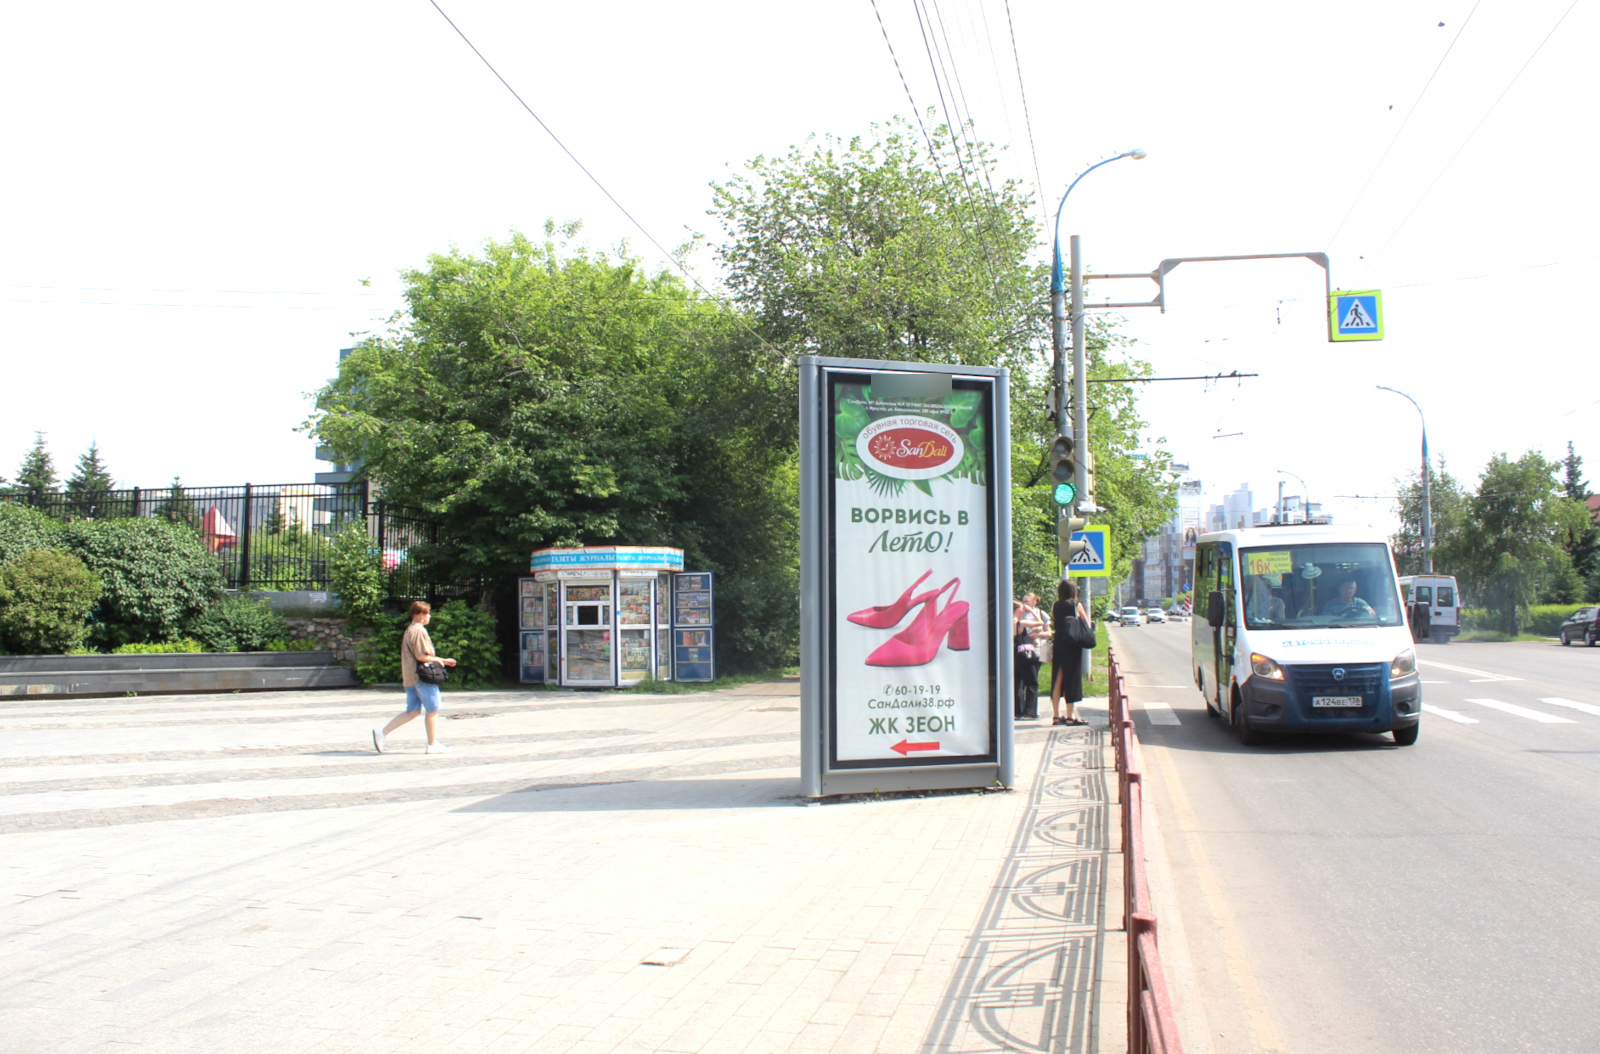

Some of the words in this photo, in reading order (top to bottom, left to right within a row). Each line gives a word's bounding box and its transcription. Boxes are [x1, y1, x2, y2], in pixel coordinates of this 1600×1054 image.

[862, 419, 897, 439] обувная
[900, 419, 939, 430] торговая
[940, 427, 957, 444] сеть
[896, 439, 948, 458] SanDali
[851, 507, 951, 525] ВОРВИСЬ
[957, 510, 969, 525] В
[551, 555, 577, 563] ГАЗЕТЫ
[579, 554, 616, 562] ЖУРНАЛЫ
[894, 685, 941, 696] 60-19-19
[867, 697, 955, 710] СанДали38.рф
[868, 716, 899, 735] ЖК
[905, 715, 955, 733] ЗЕОН
